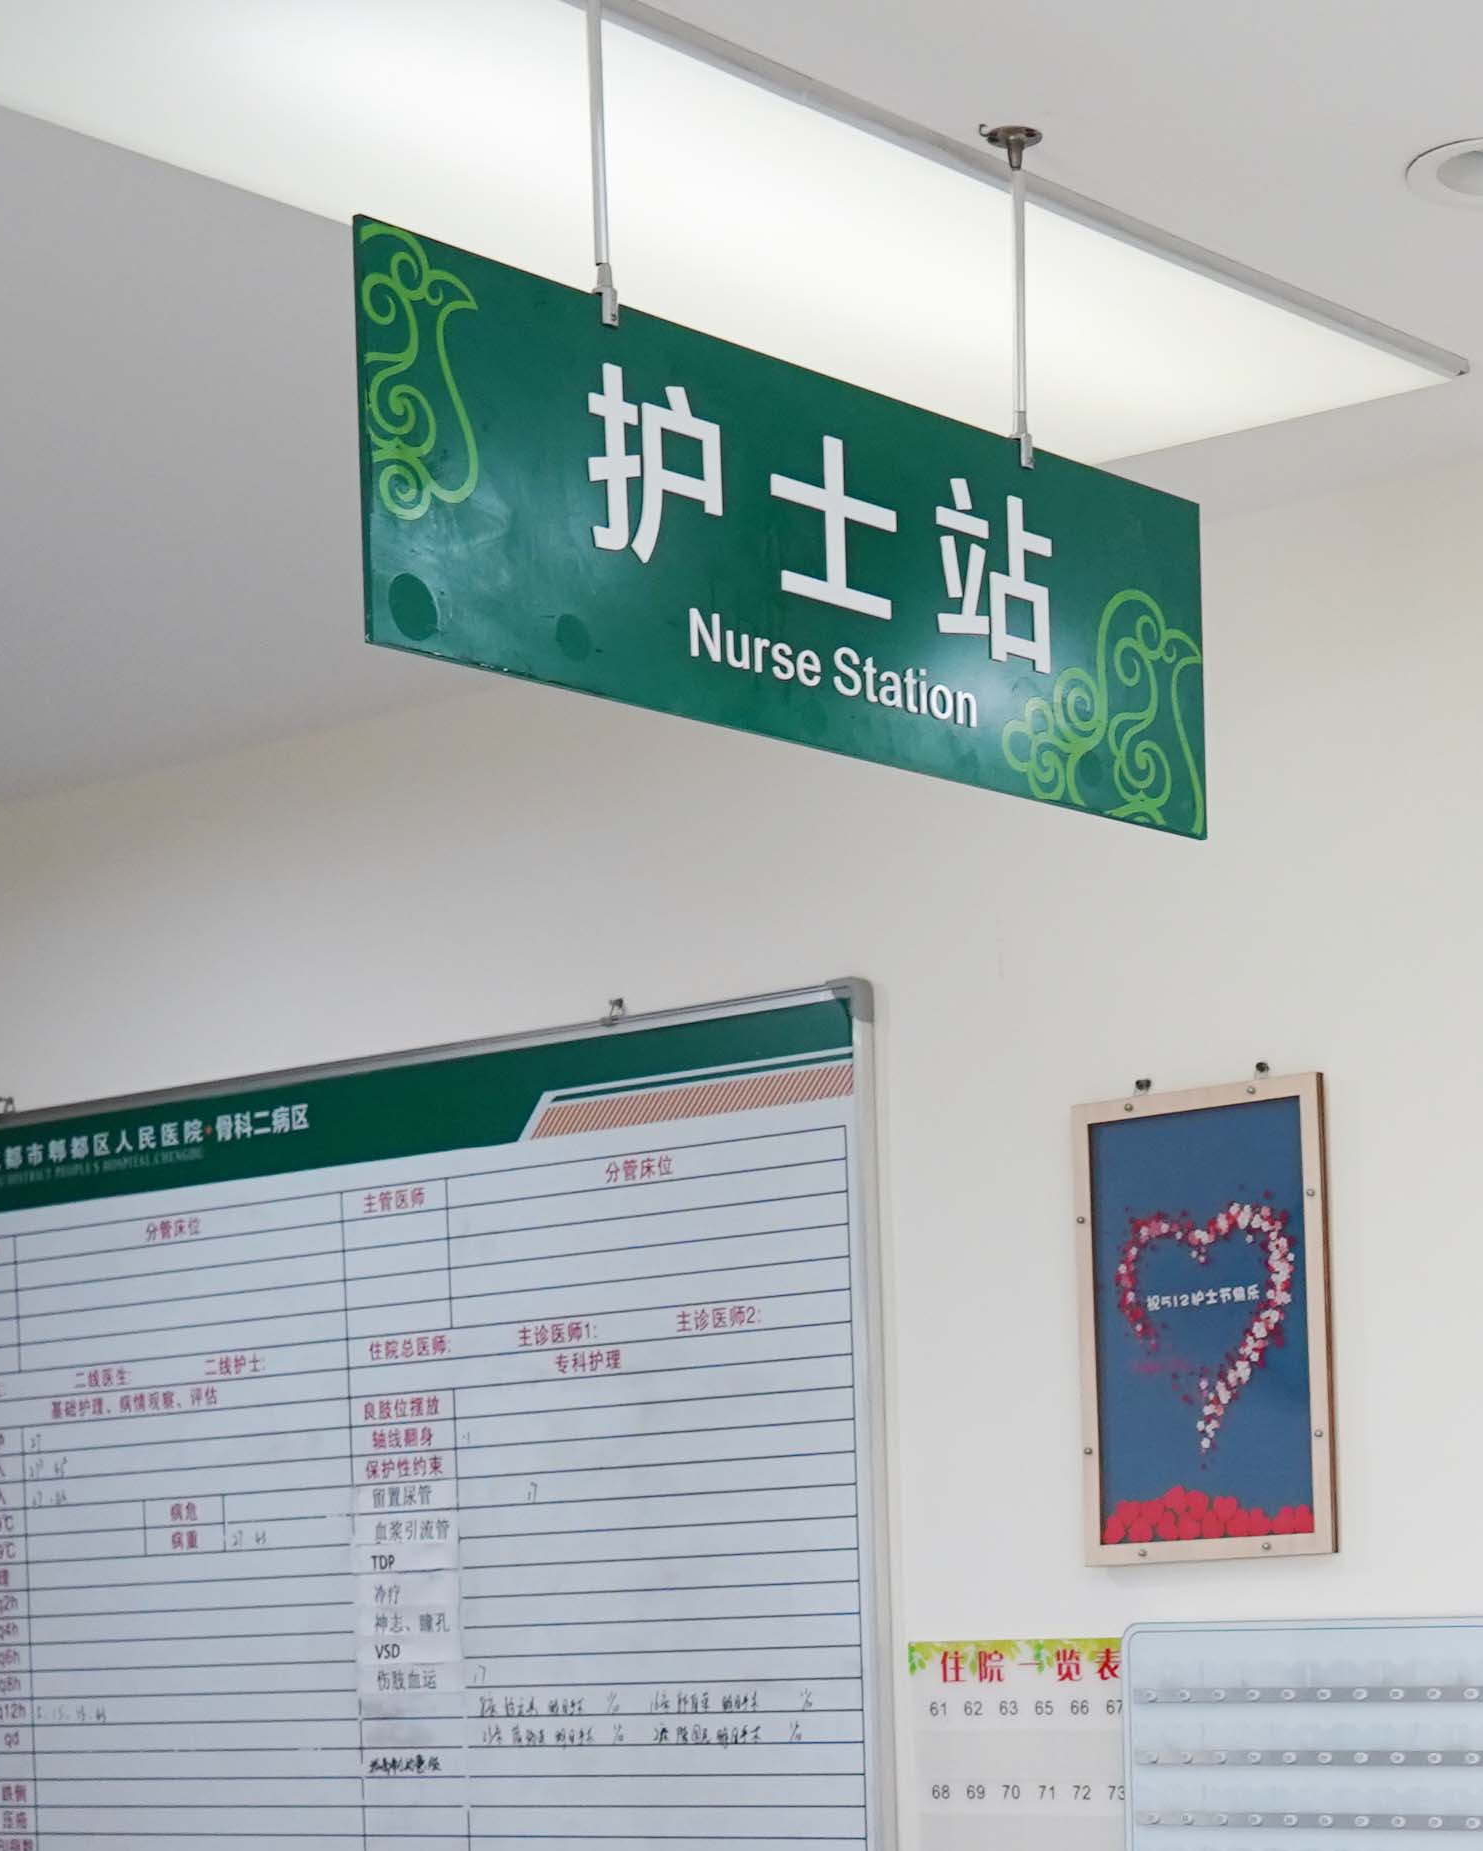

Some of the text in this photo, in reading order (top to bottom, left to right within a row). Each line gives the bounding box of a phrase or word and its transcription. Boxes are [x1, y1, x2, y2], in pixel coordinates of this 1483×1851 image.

[588, 362, 1054, 674] 护士站
[689, 606, 978, 729] Nurse Station
[604, 1153, 675, 1184] 分管床位
[362, 1188, 427, 1216] 主管医师
[145, 1216, 202, 1242] 分管床位
[555, 1349, 622, 1374] 专科护理
[365, 1455, 444, 1480] 保护性约束
[372, 1485, 433, 1509] 留置尿管
[170, 1502, 198, 1522] 病危
[170, 1529, 198, 1550] 病重
[374, 1519, 451, 1542] 血浆引流管
[371, 1554, 395, 1570] TDP
[374, 1584, 401, 1605] 冷疗
[374, 1643, 401, 1659] VSD
[940, 1647, 1122, 1683] 住院一览表
[929, 1699, 1124, 1717] 61 62 63 65 66 67
[4, 1731, 20, 1748] qd
[931, 1784, 951, 1800] 68
[966, 1784, 986, 1800] 69
[1002, 1784, 1021, 1800] 70
[1038, 1784, 1056, 1800] 71
[1072, 1785, 1092, 1801] 72
